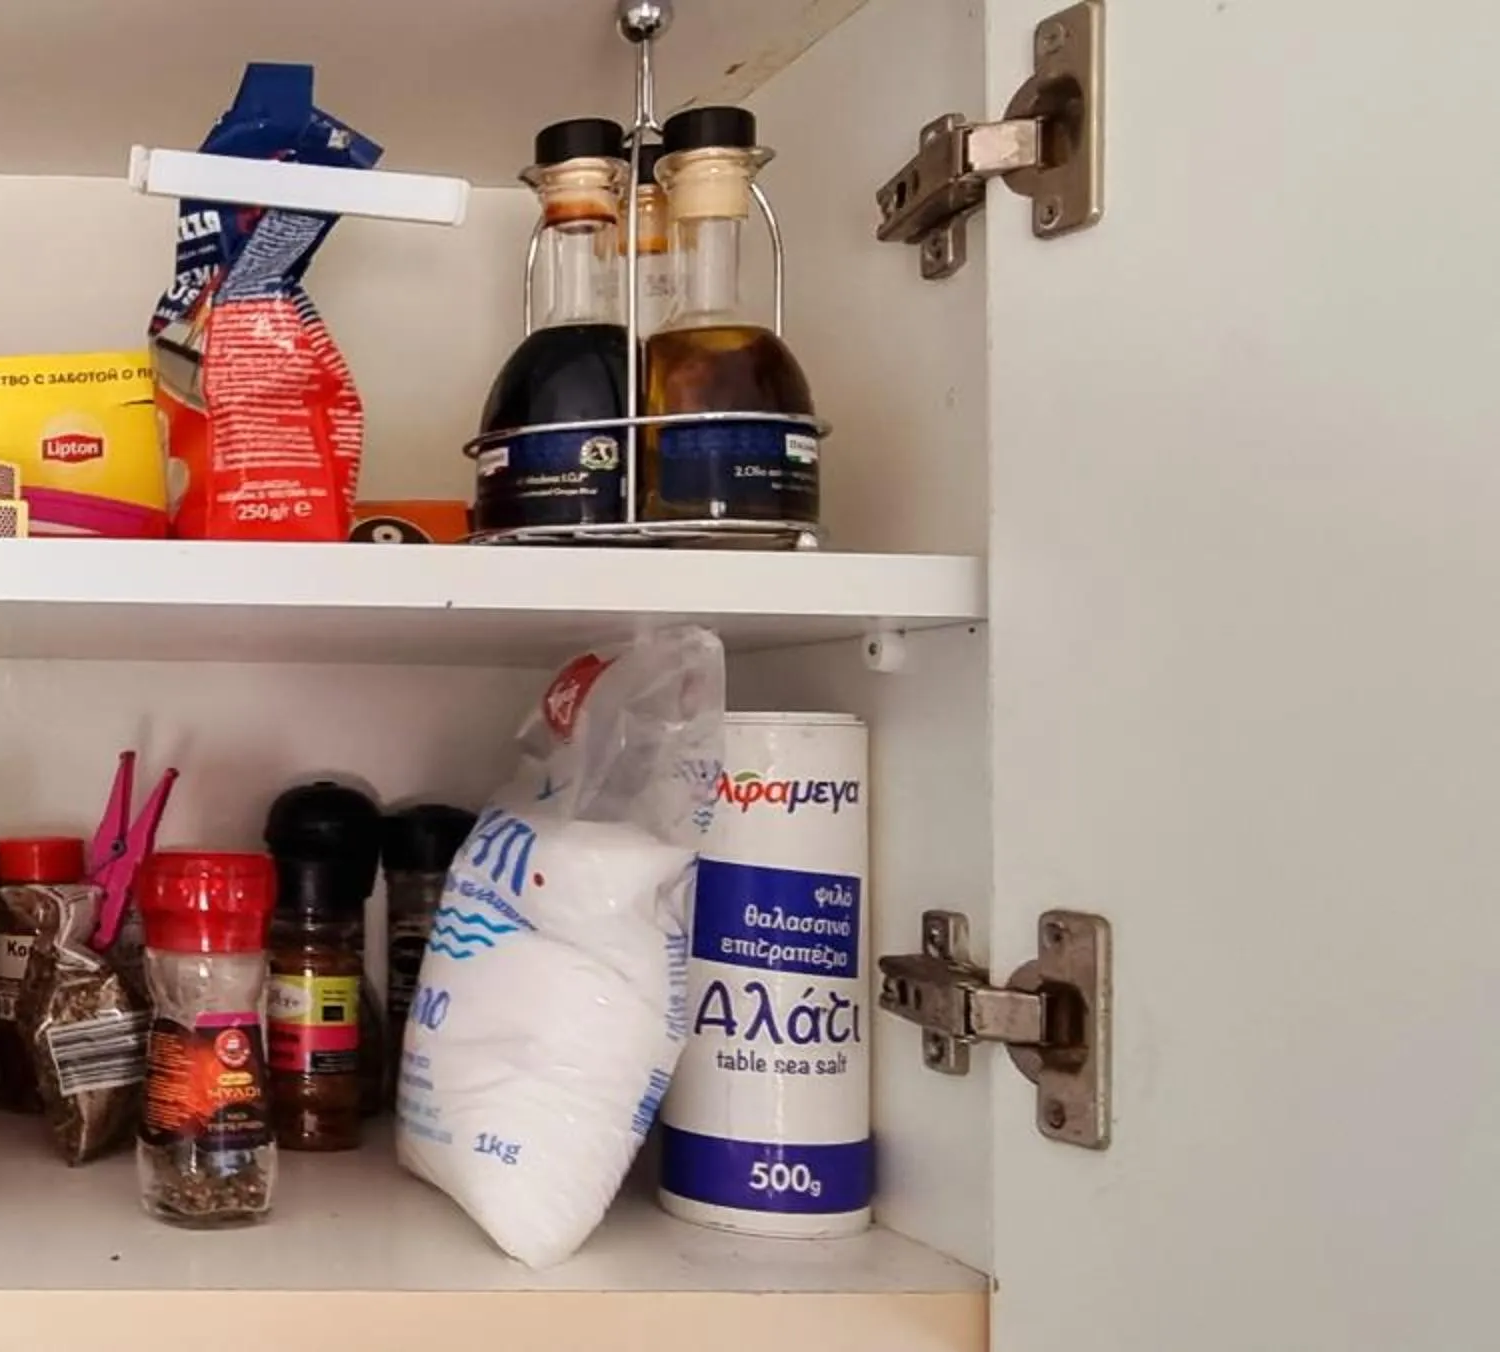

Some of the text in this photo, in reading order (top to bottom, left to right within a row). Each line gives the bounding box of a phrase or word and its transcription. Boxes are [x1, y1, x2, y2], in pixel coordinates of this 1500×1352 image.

[33, 373, 45, 385] С
[49, 368, 119, 385] ЗАБОТОЙ
[121, 368, 134, 380] О
[47, 437, 100, 458] Lipton
[744, 904, 851, 936] θαλασσινό
[720, 936, 849, 968] επιτραπέζιο
[694, 979, 861, 1044] Αλάτι
[716, 1048, 848, 1075] table sea salt
[472, 1132, 522, 1166] 1kg
[749, 1161, 822, 1198] 500g
